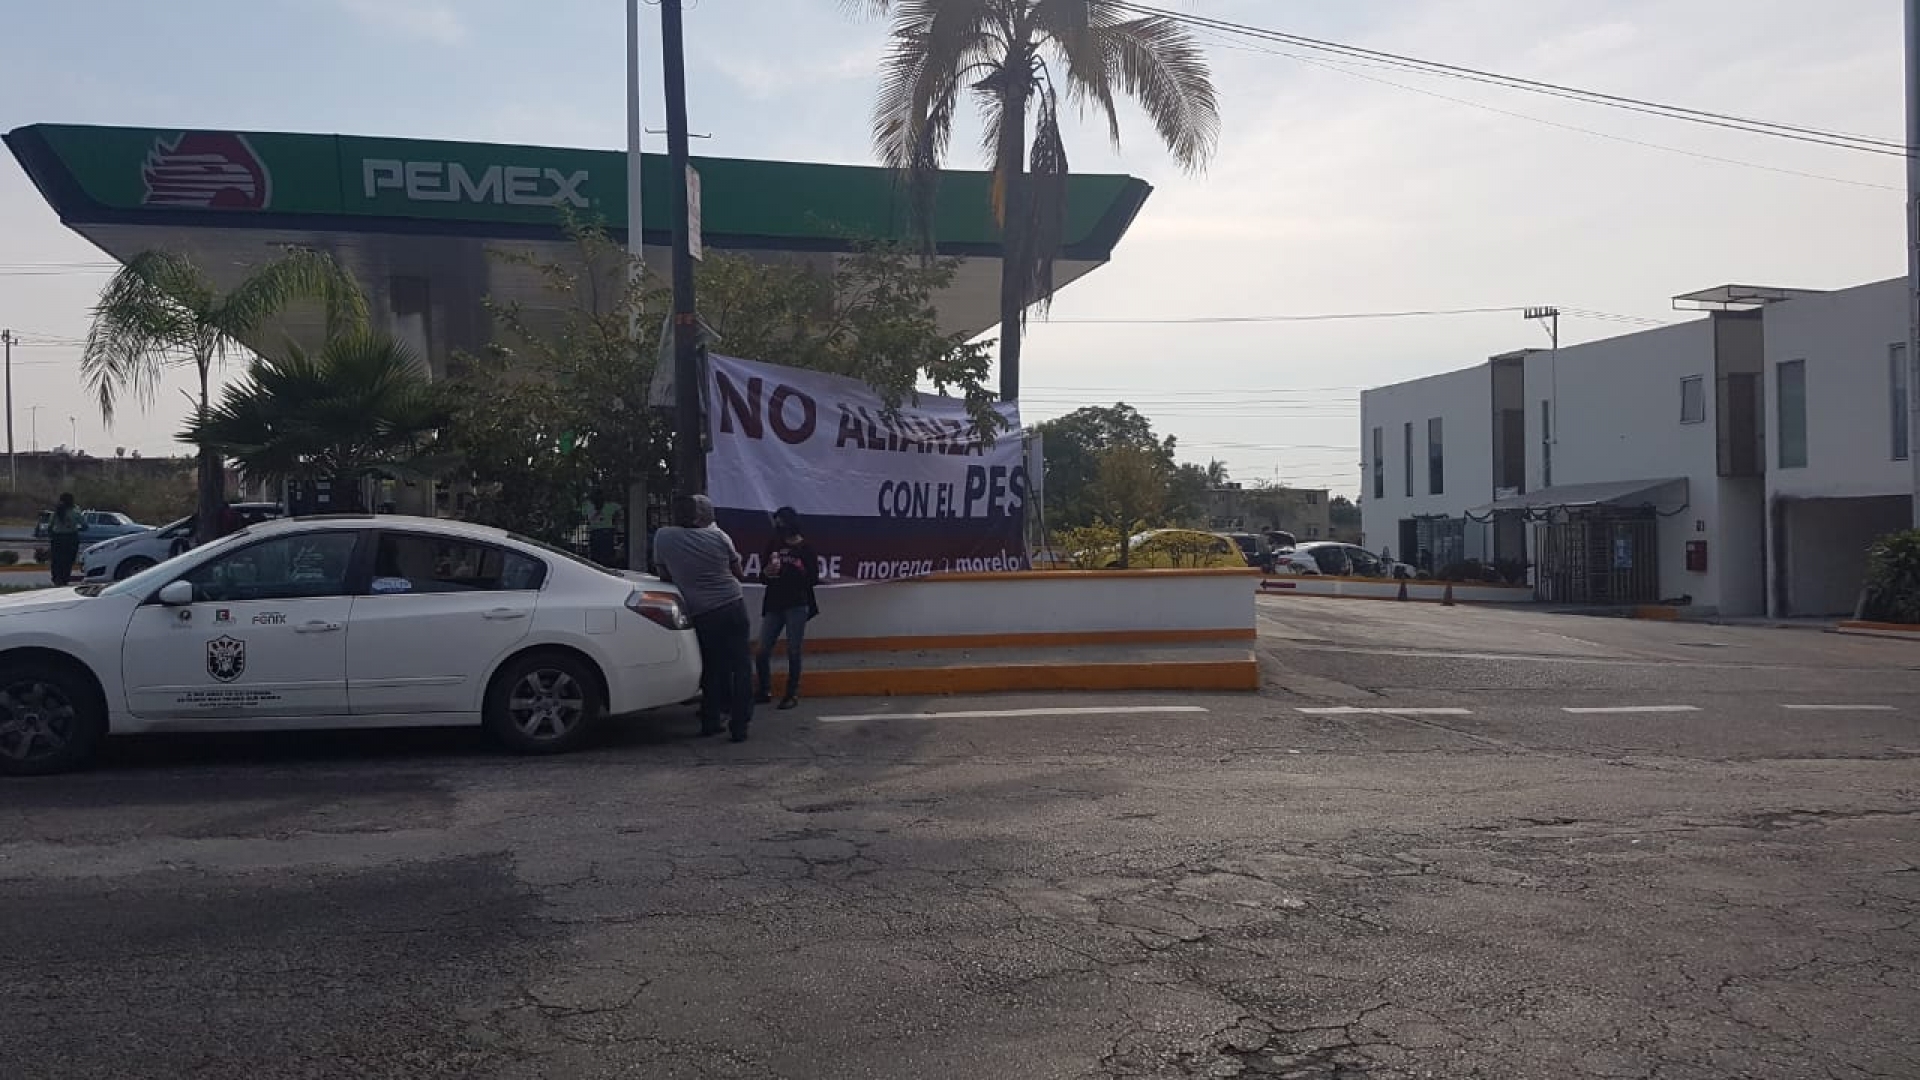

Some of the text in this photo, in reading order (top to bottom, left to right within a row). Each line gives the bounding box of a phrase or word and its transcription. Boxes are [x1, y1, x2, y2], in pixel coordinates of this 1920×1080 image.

[363, 158, 588, 207] PEMEX
[715, 371, 985, 456] NO ALIANZA
[878, 464, 1025, 522] CON EL PES
[857, 559, 933, 579] morena
[956, 549, 1023, 573] morelo
